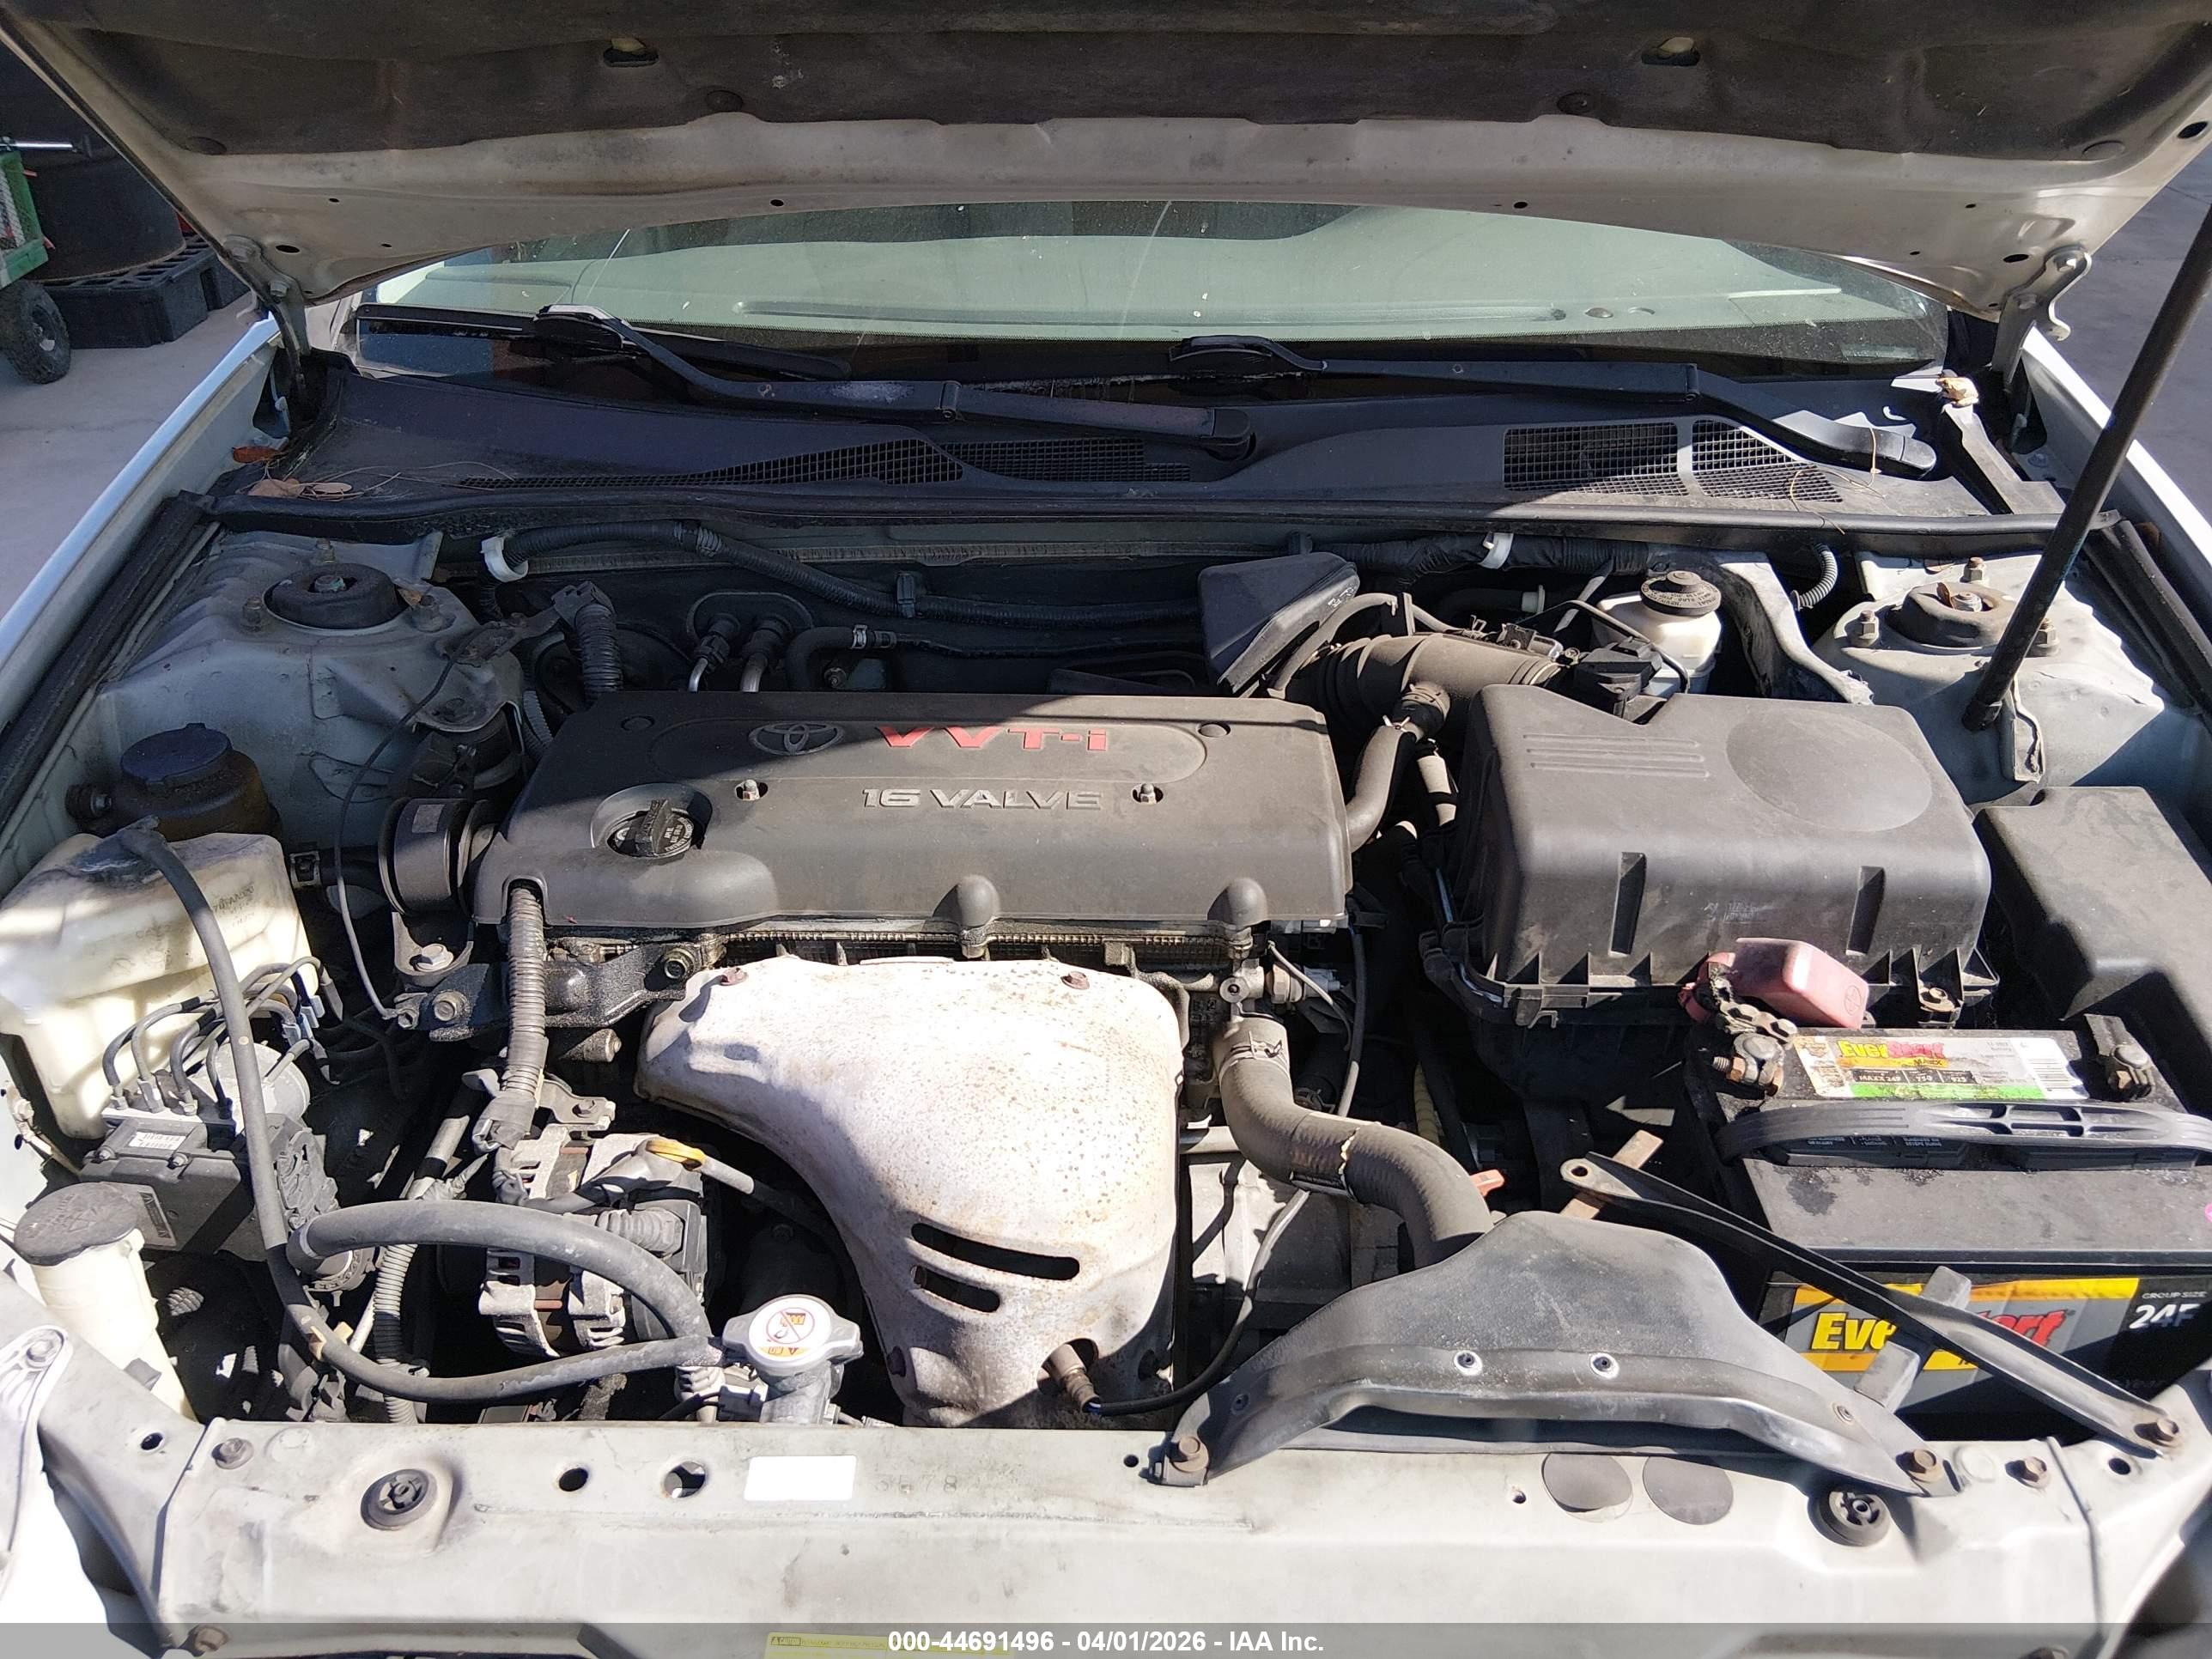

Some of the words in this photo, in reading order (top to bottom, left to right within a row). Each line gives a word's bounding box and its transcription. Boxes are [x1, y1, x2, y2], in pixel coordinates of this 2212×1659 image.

[876, 726, 1107, 751] VVT-i
[862, 788, 921, 808] 16
[929, 788, 1103, 810] VALVE
[2129, 1303, 2201, 1330] 24F
